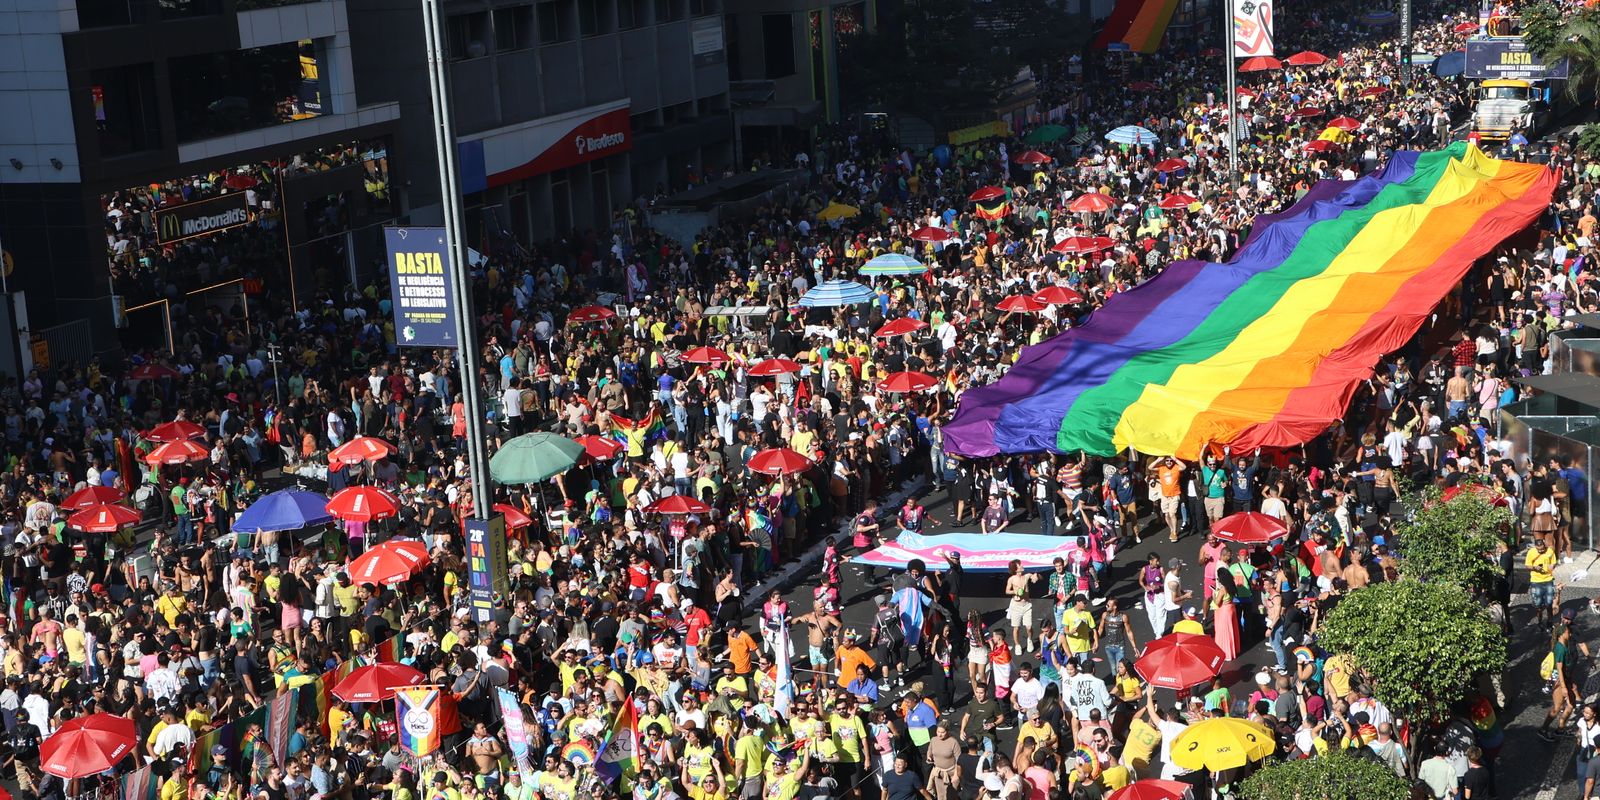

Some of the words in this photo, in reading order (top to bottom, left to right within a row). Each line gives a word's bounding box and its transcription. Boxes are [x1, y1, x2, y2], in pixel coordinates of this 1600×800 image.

[1500, 52, 1532, 65] BASTA
[587, 132, 625, 152] Bradesco
[183, 208, 247, 235] McDonald's
[395, 252, 444, 274] BASTA
[398, 276, 407, 285] DE
[407, 275, 445, 286] NEGLIGÊNCIA
[399, 286, 405, 297] E
[404, 286, 446, 297] RETROCESSO
[400, 298, 410, 307] NO
[410, 298, 447, 308] LEGISLATIVO
[1079, 693, 1096, 706] BABY
[1135, 729, 1155, 746] 13
[110, 743, 127, 759] AMSTEL
[50, 763, 68, 772] AMSTEL
